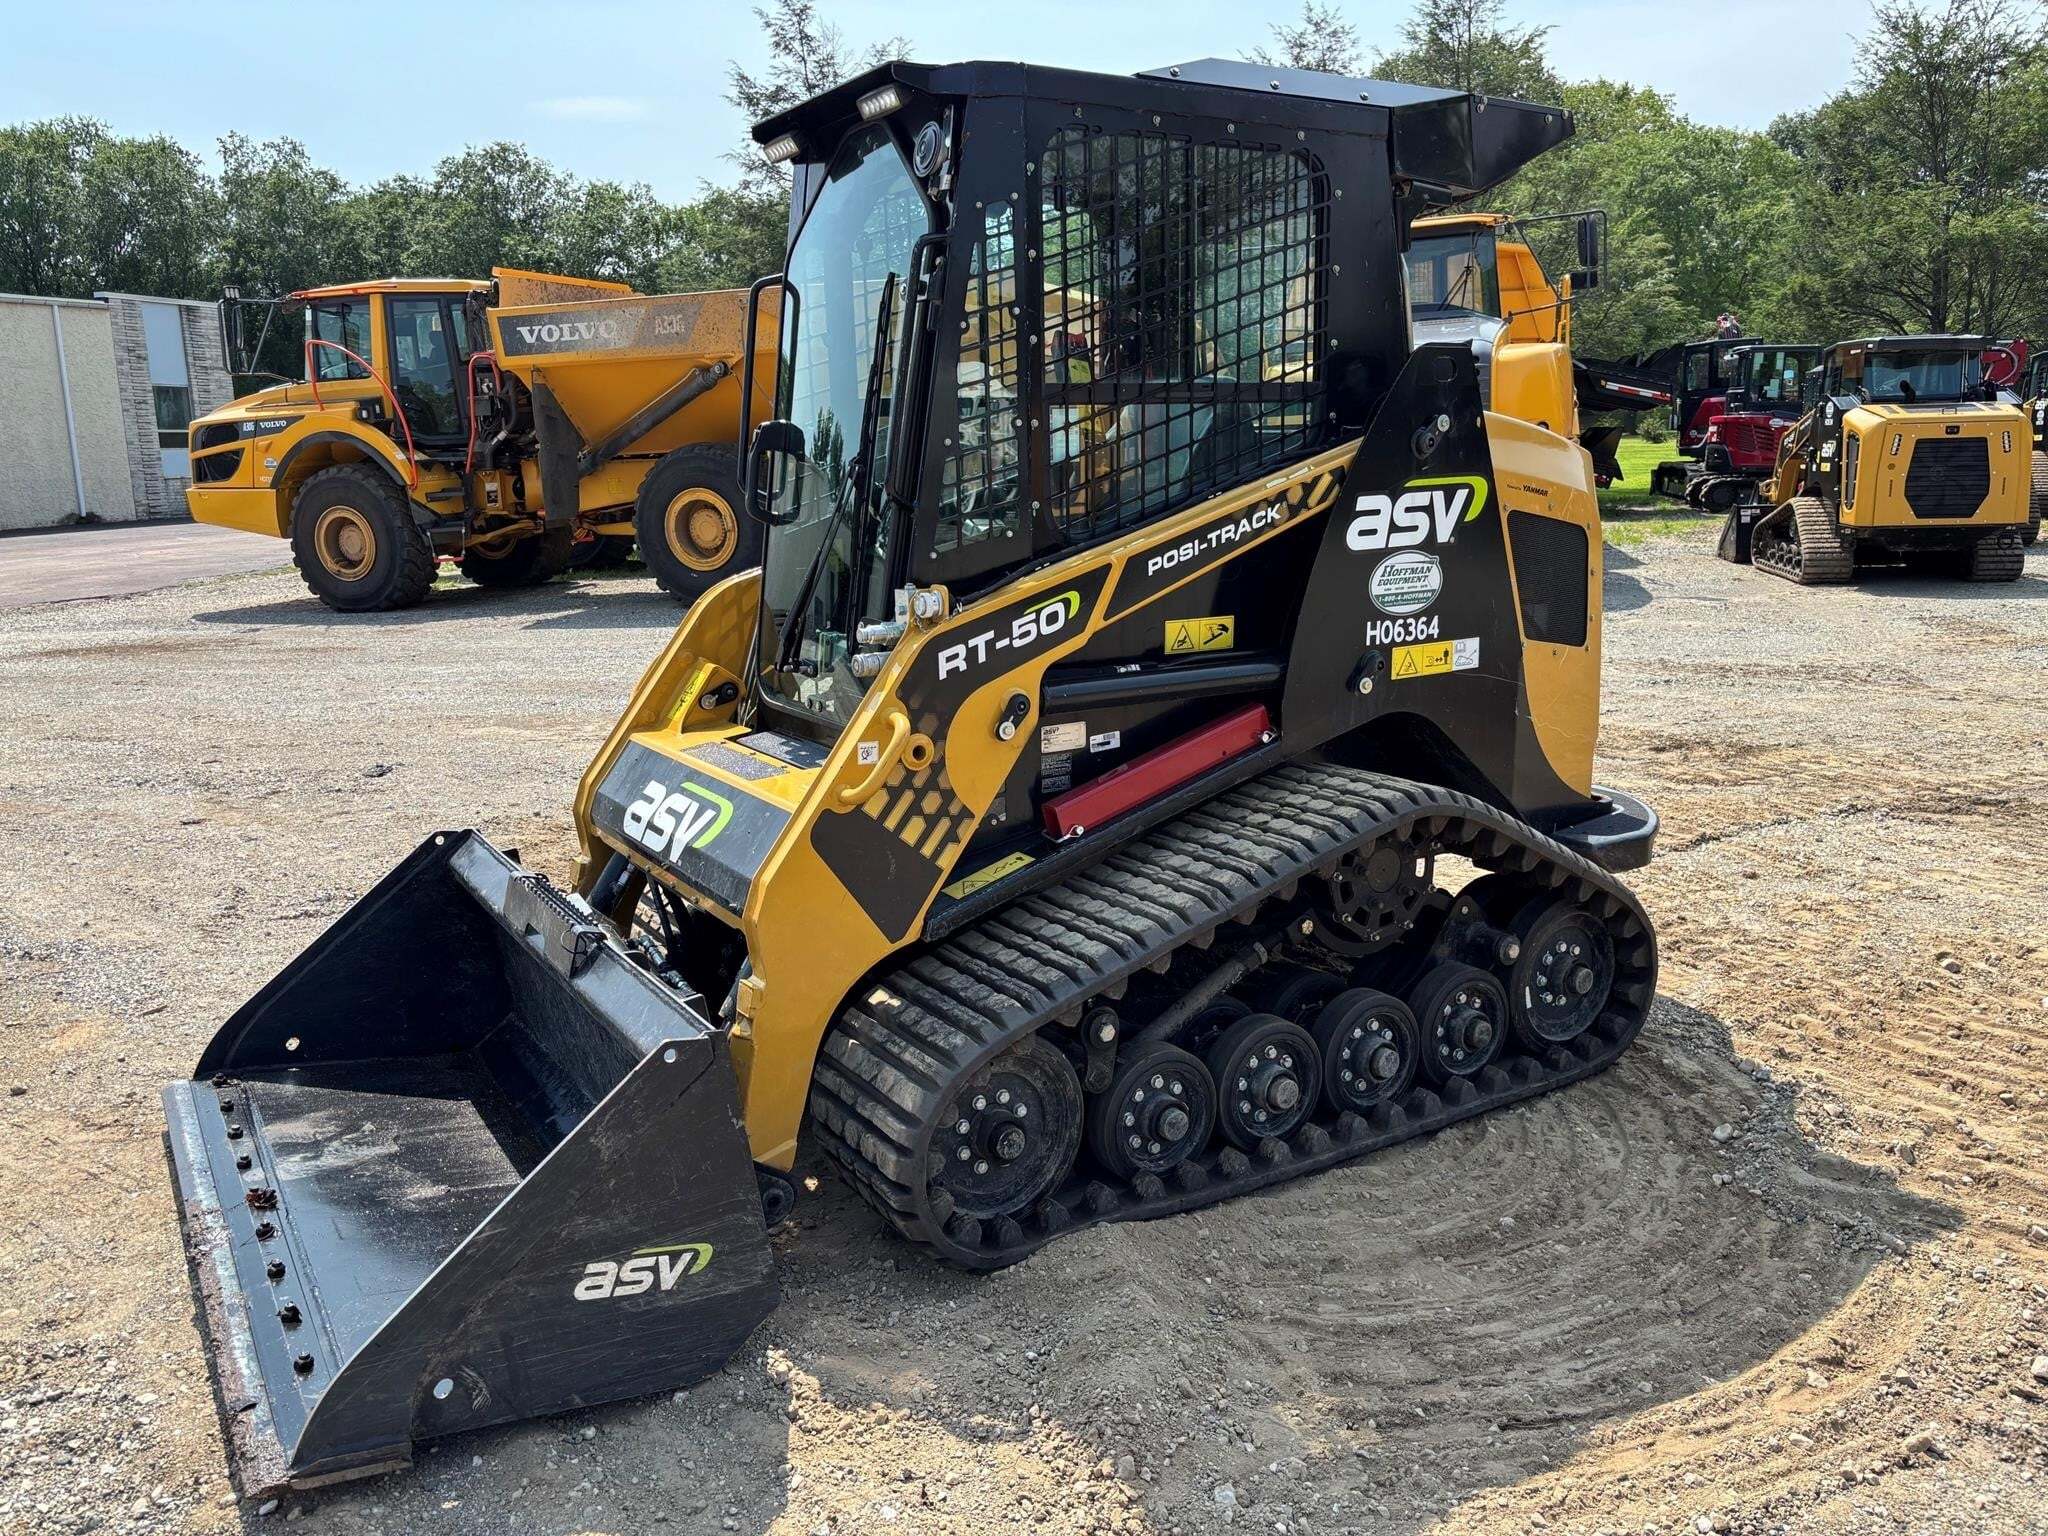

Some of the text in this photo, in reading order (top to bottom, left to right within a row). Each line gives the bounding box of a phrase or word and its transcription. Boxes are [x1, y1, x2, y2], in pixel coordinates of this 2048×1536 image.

[517, 319, 618, 344] VOLVO
[259, 420, 287, 429] VOLVO
[1147, 502, 1283, 577] POSI-TRACK
[1377, 575, 1429, 587] EQUIPMENT
[1380, 564, 1433, 578] HOFFMAN
[938, 601, 1066, 681] RT-50
[1366, 615, 1440, 646] H06364
